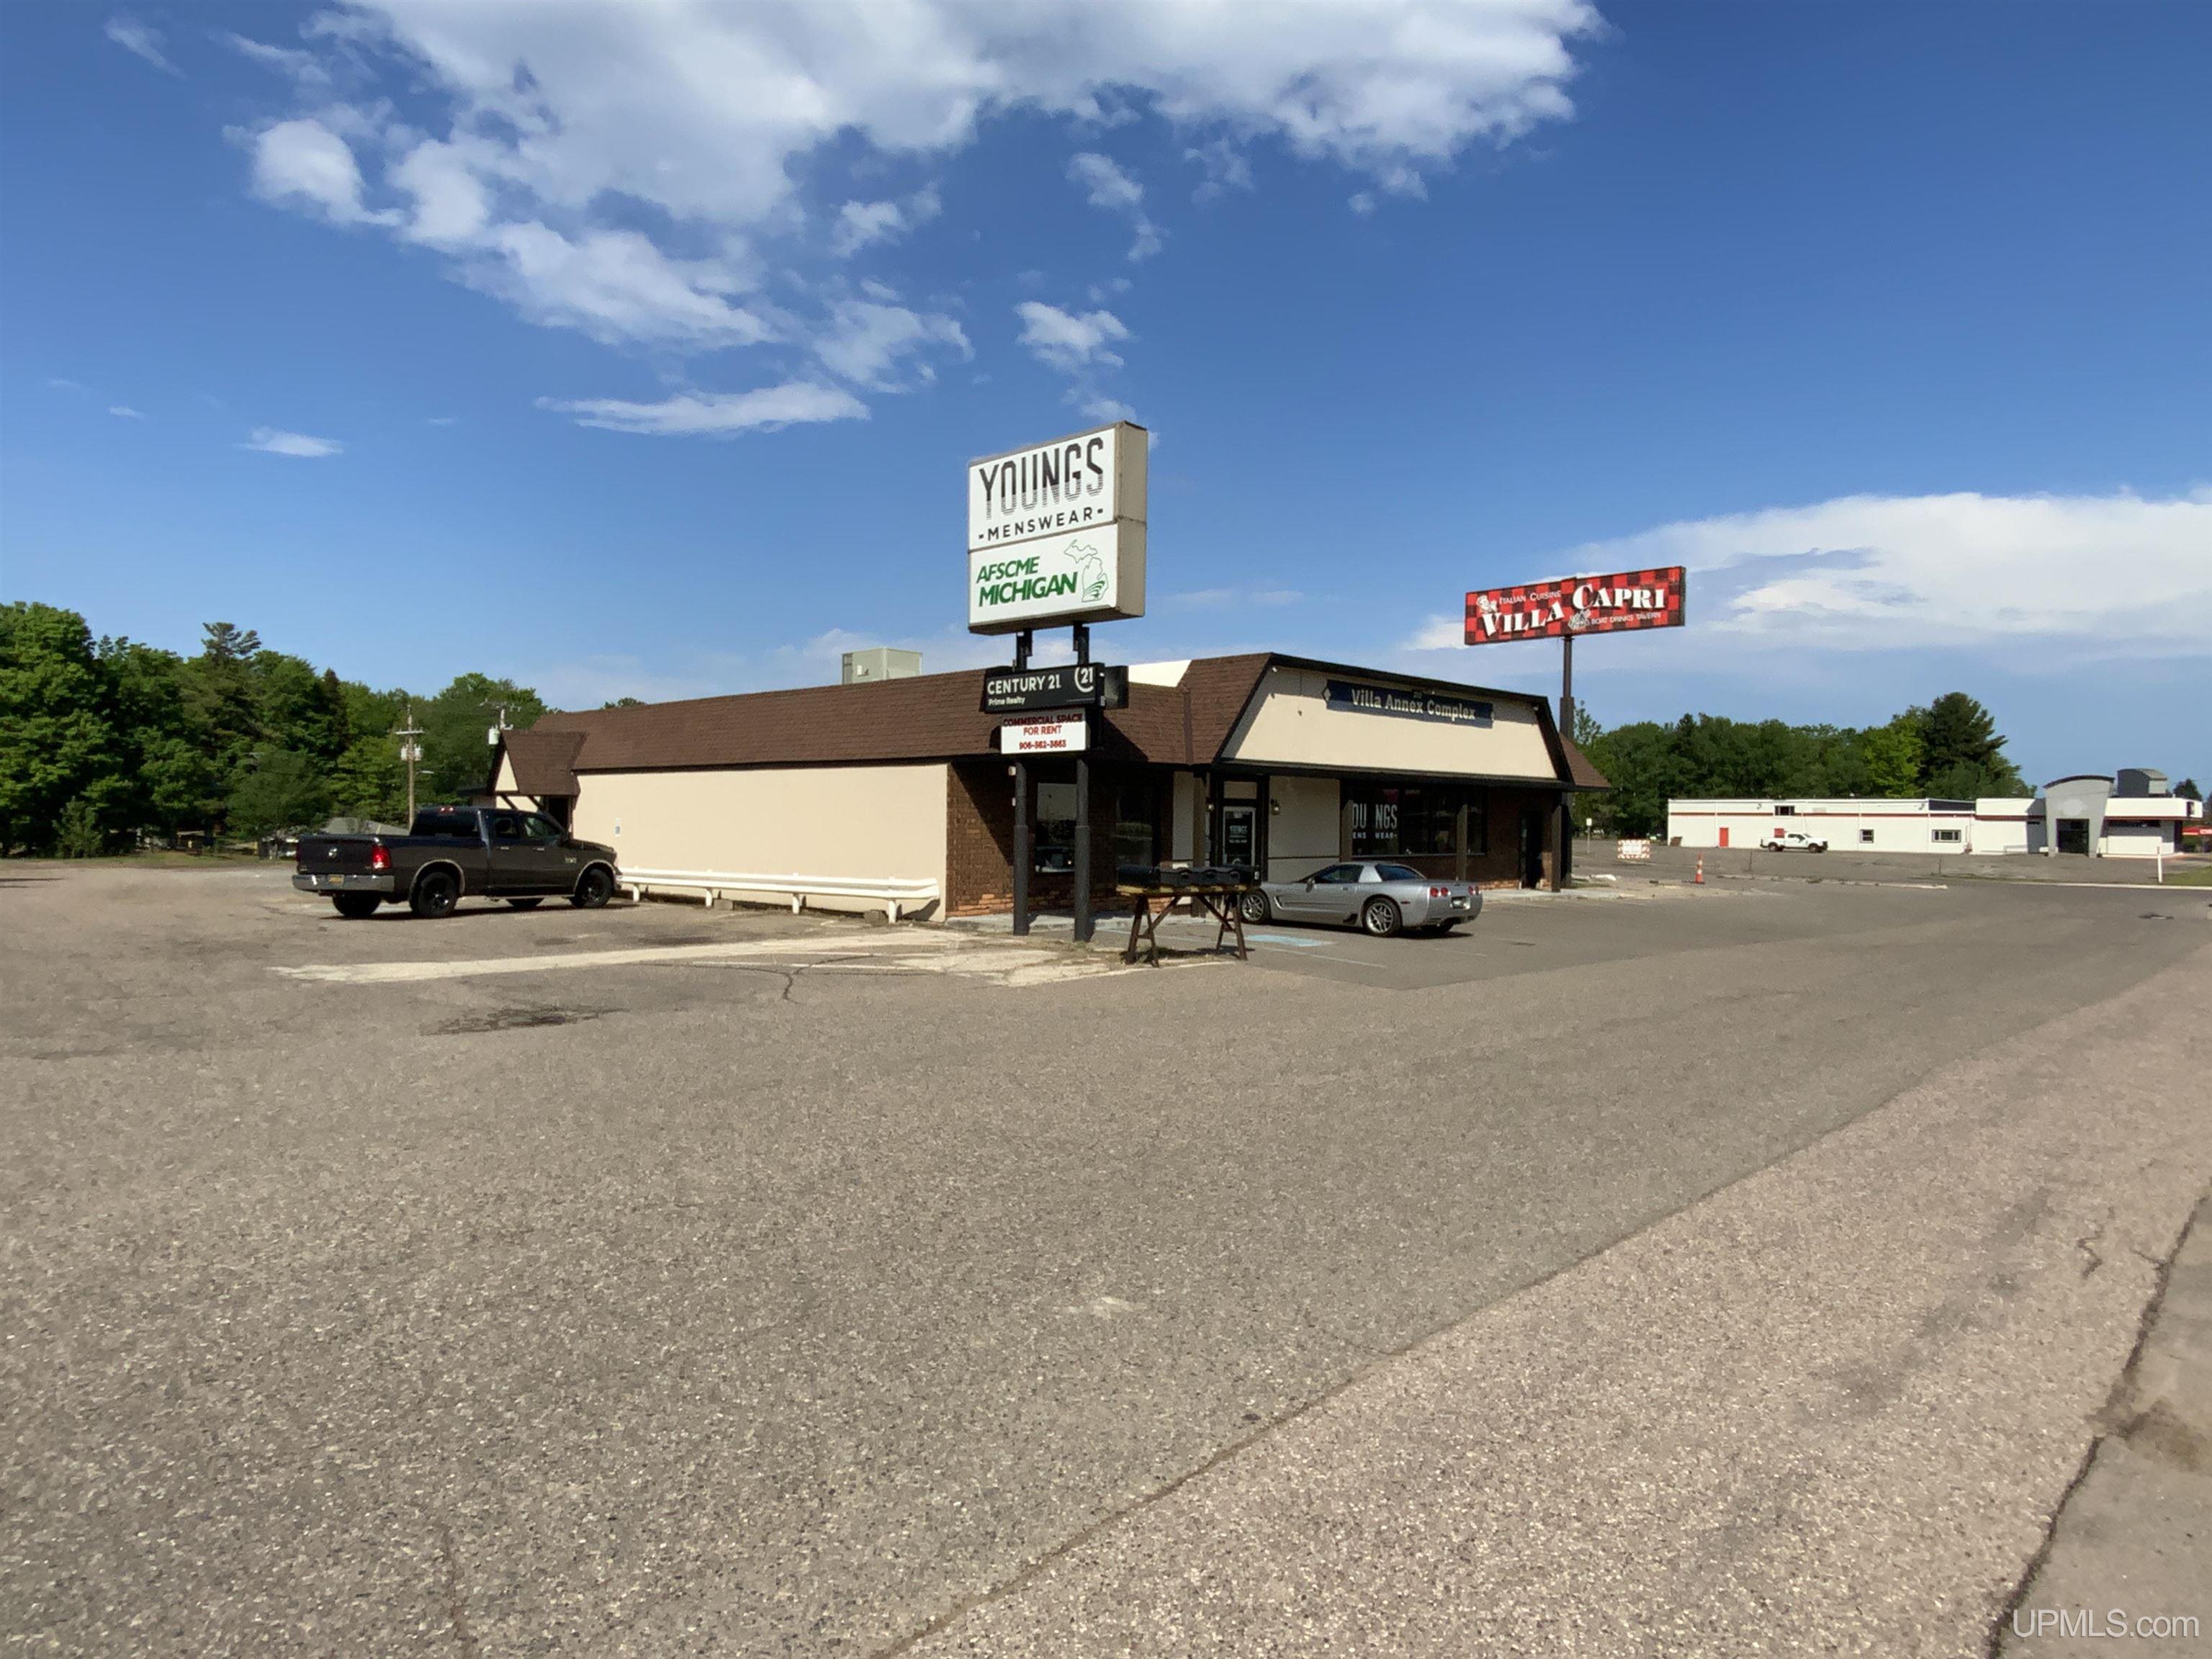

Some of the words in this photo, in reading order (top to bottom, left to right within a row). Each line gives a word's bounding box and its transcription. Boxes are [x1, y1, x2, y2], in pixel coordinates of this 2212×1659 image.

[979, 437, 1104, 520] YOUNGS
[976, 556, 1040, 584] AFSCME
[979, 571, 1079, 607] MICHIGAN
[1499, 595, 1526, 605] ITALIAN
[1482, 601, 1565, 637] VILLA
[1573, 584, 1665, 610] CAPRI
[987, 675, 1046, 695] CENTURY
[1048, 674, 1062, 690] 21
[1352, 688, 1382, 708] Villa
[1385, 694, 1424, 714] Annex
[1427, 701, 1475, 721] Complex
[1003, 716, 1054, 727] COMMERCIAL
[1056, 713, 1083, 723] SPACE
[1023, 726, 1038, 735] FOR
[1041, 725, 1062, 734] RENT
